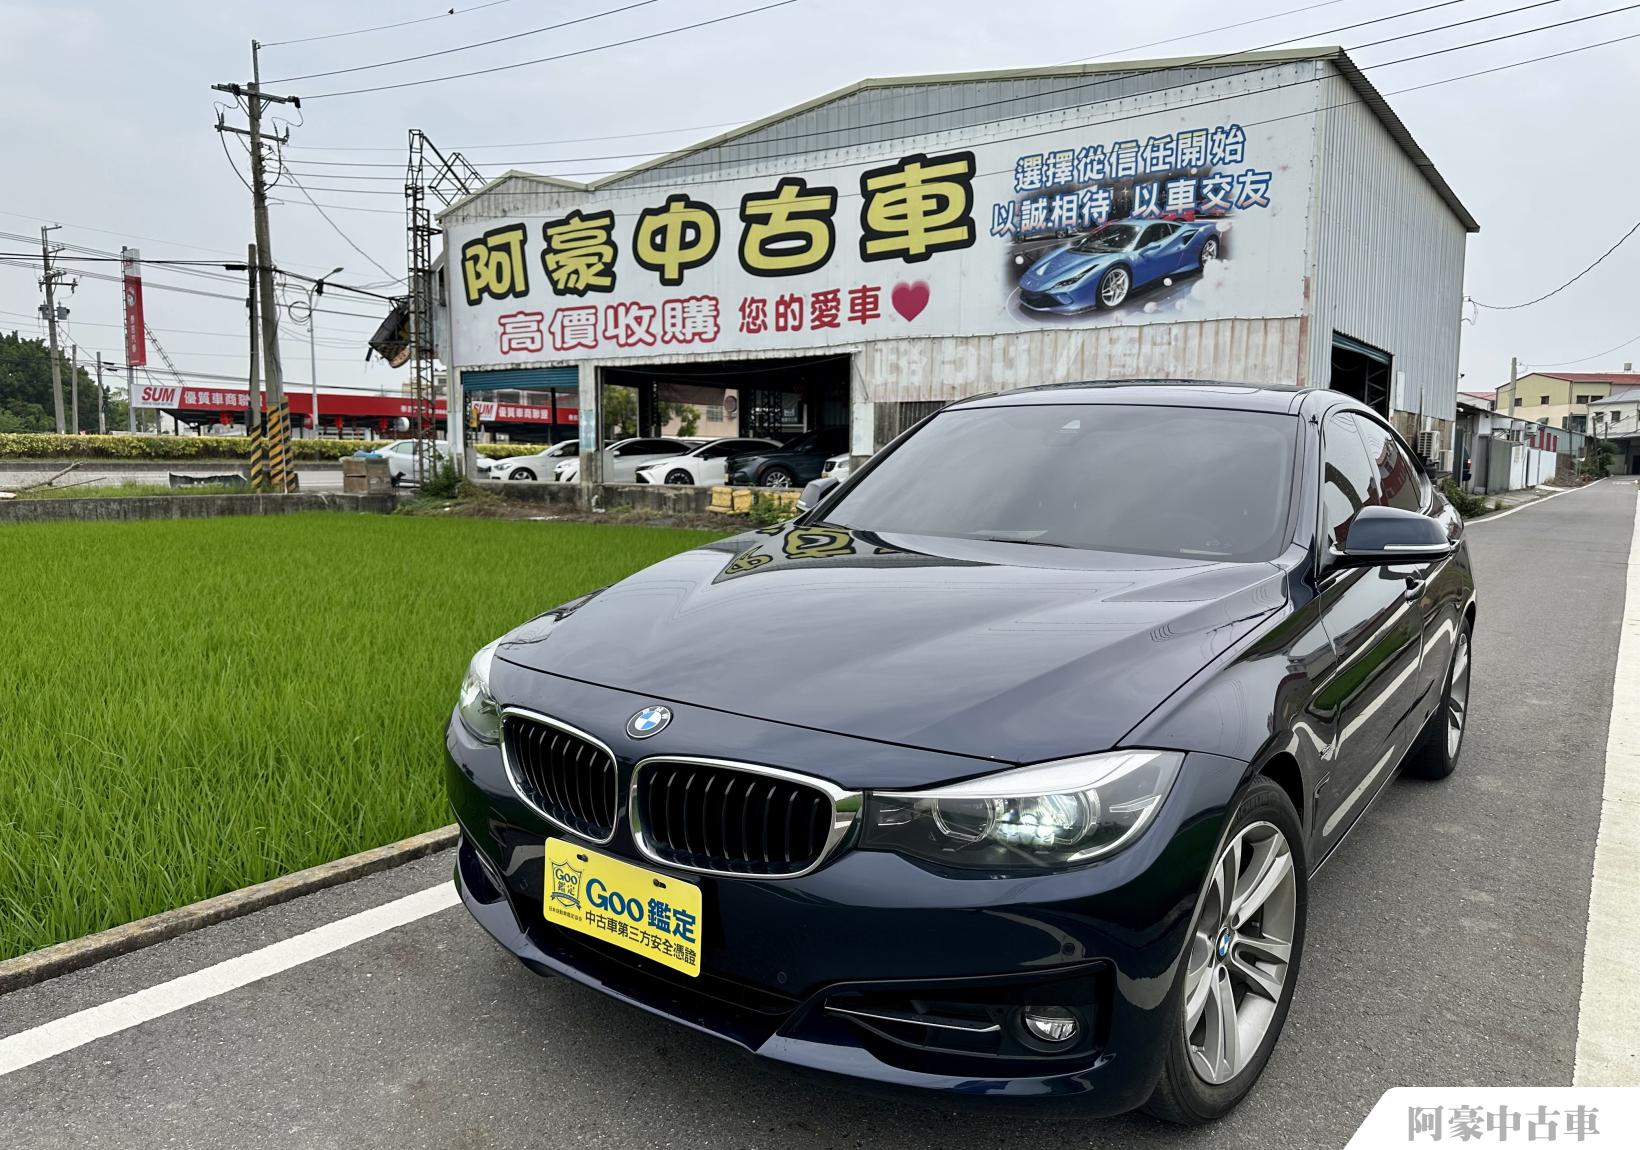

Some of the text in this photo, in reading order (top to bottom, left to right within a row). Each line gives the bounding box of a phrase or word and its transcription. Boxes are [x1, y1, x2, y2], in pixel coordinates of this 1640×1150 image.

[1014, 124, 1247, 192] 選擇從信任開始
[462, 151, 977, 306] 阿豪中古車
[990, 169, 1273, 237] 以誠相待 以車交友
[499, 284, 882, 354] 高價收購 您的愛車
[142, 386, 175, 402] SUM
[184, 390, 264, 408] 優質車商聯
[555, 868, 578, 886] Goo
[585, 878, 697, 944] Goo 鑑定
[585, 910, 697, 967] 中古車第三方安全憑證
